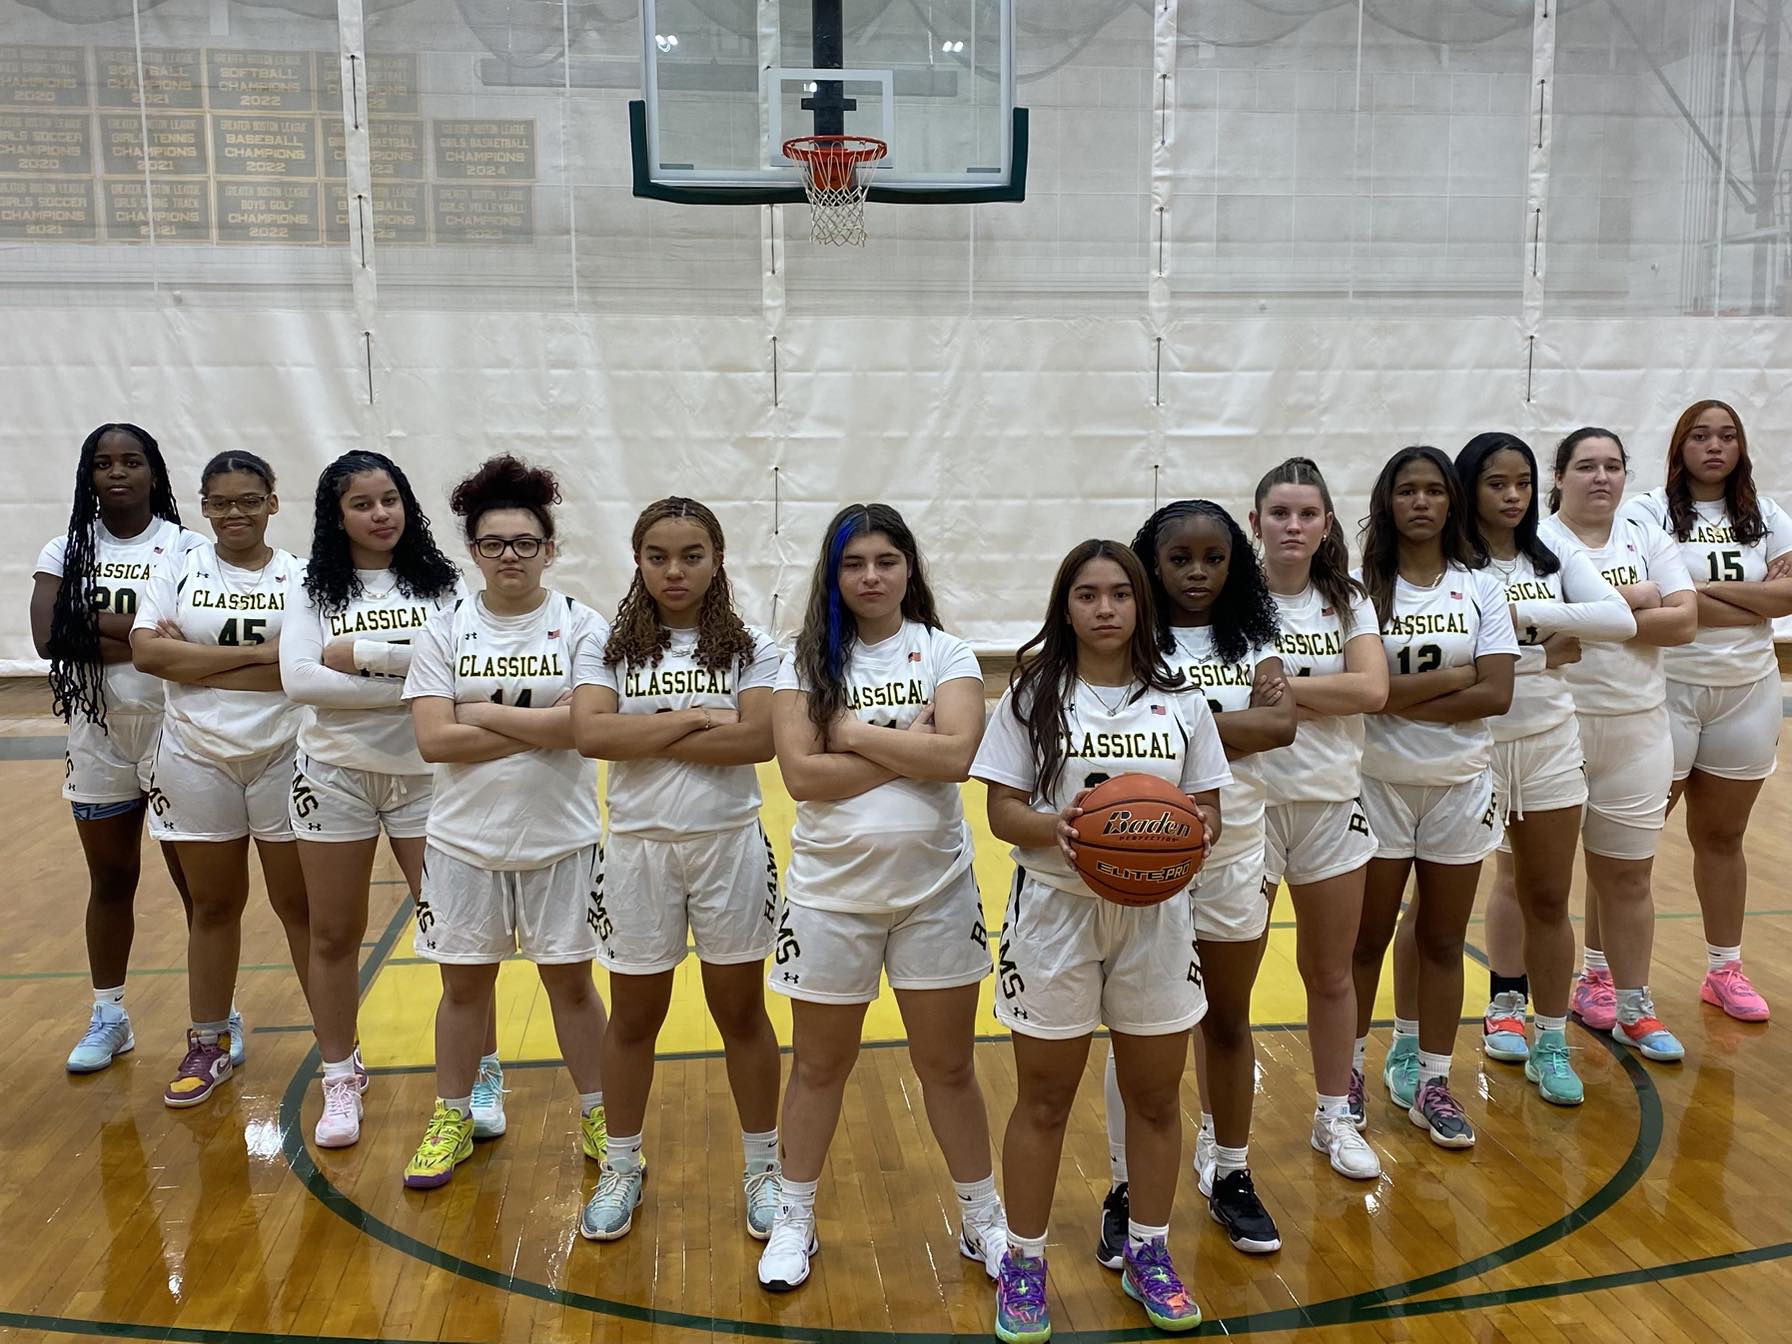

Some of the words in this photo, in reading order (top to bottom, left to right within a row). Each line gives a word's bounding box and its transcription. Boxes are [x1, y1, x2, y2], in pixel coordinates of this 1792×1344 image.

[220, 67, 299, 79] SOFTBALL
[218, 82, 300, 93] CHAMPIONS
[240, 95, 281, 106] 2022
[153, 134, 195, 144] TENNIS
[225, 134, 304, 146] BASEBALL
[224, 148, 305, 160] CHAMPIONS
[446, 152, 525, 163] CHAMPIONS
[246, 161, 286, 172] 2022
[466, 165, 508, 176] 2024
[1, 210, 85, 222] CHAMPIONS
[228, 213, 309, 225] CHAMPIONS
[249, 227, 288, 238] 2022
[93, 562, 151, 580] ASSICA
[1707, 551, 1744, 582] 15
[1380, 612, 1469, 636] LASSICAL
[219, 618, 266, 646] 45
[1274, 630, 1343, 656] ASSICAL
[1397, 644, 1442, 674] 12
[459, 653, 564, 678] CLASSICAL
[625, 669, 732, 698] CLASSICAL
[845, 679, 930, 710] LASSICAL
[1103, 810, 1192, 839] Baden
[1096, 860, 1164, 881] ELITE
[1162, 860, 1193, 881] PRO
